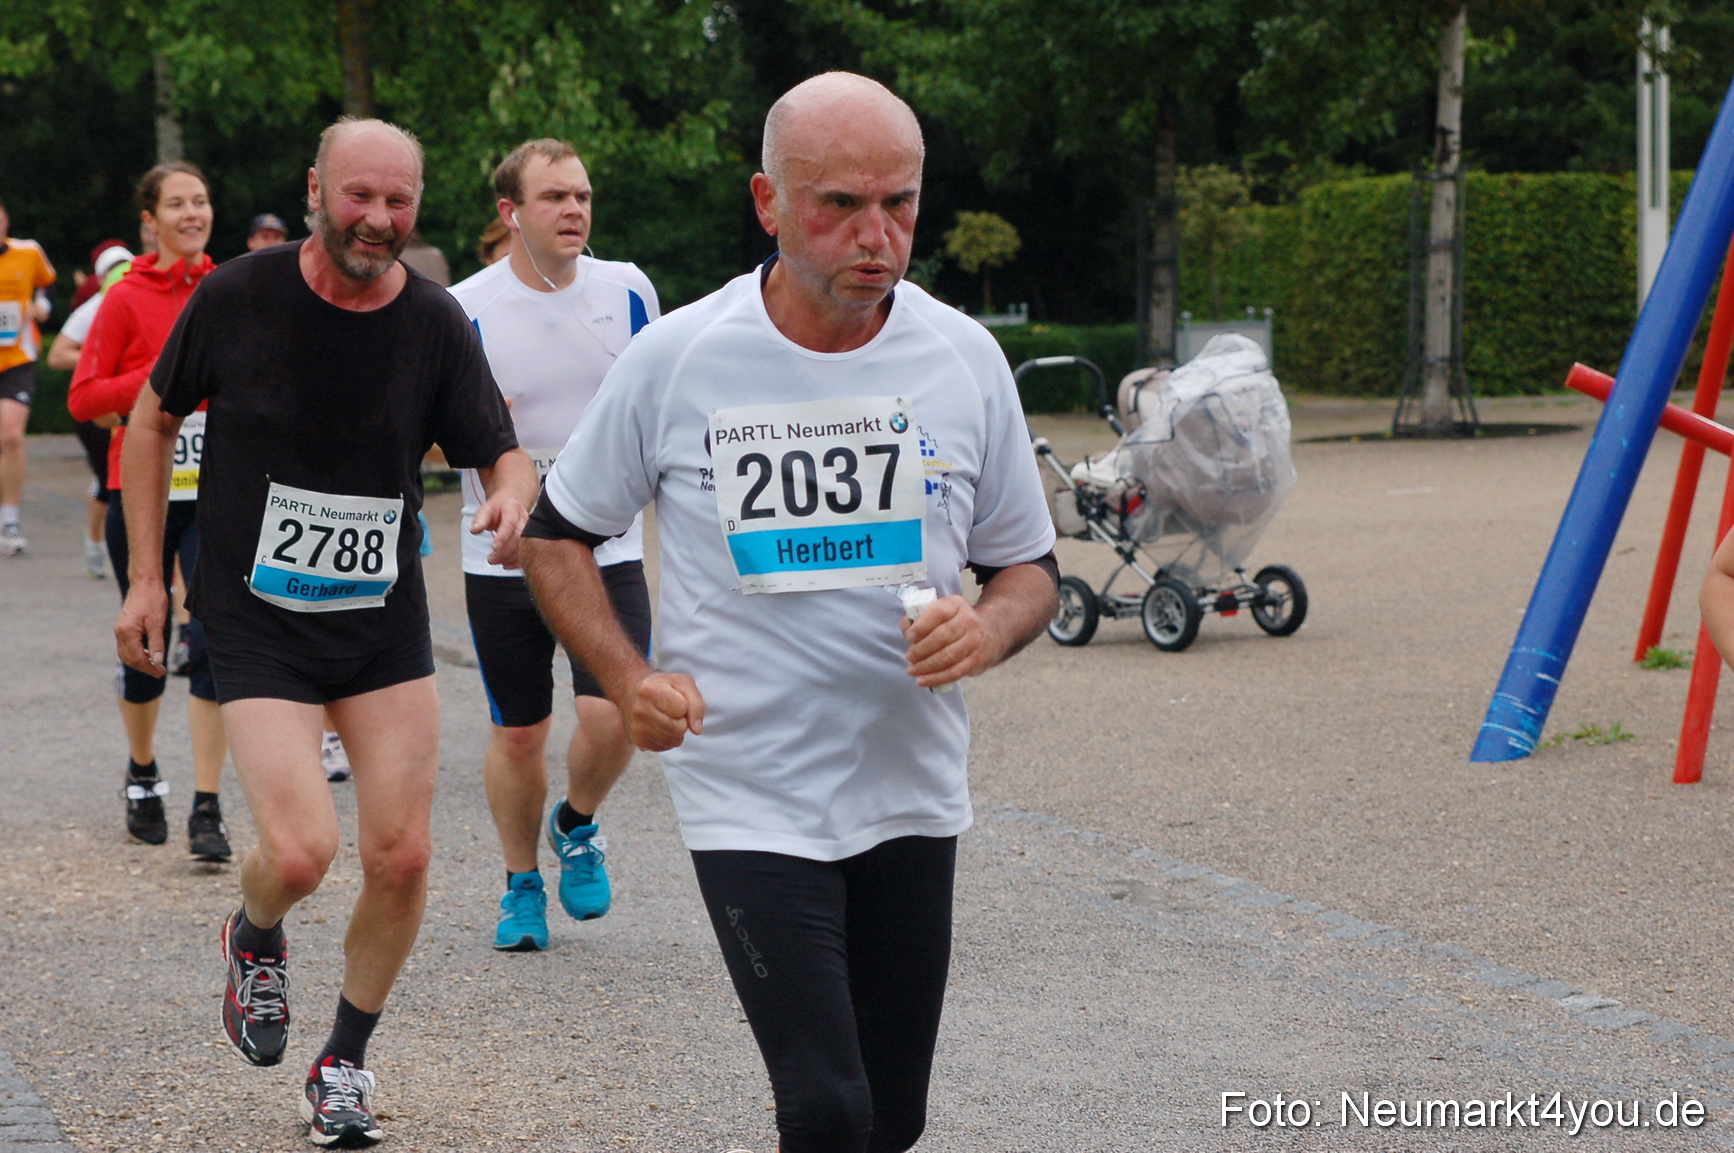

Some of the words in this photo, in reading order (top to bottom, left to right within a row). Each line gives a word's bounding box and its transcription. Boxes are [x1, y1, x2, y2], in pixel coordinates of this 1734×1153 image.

[716, 425, 781, 445] PARTL
[787, 417, 882, 439] Neumarkt
[736, 443, 901, 521] 2037
[270, 496, 316, 516] PARTL
[320, 506, 379, 522] Neumarkt
[727, 519, 736, 532] D
[261, 555, 267, 564] C
[271, 518, 385, 576] 2788
[776, 533, 874, 565] Herbert
[286, 577, 358, 599] Gerhard
